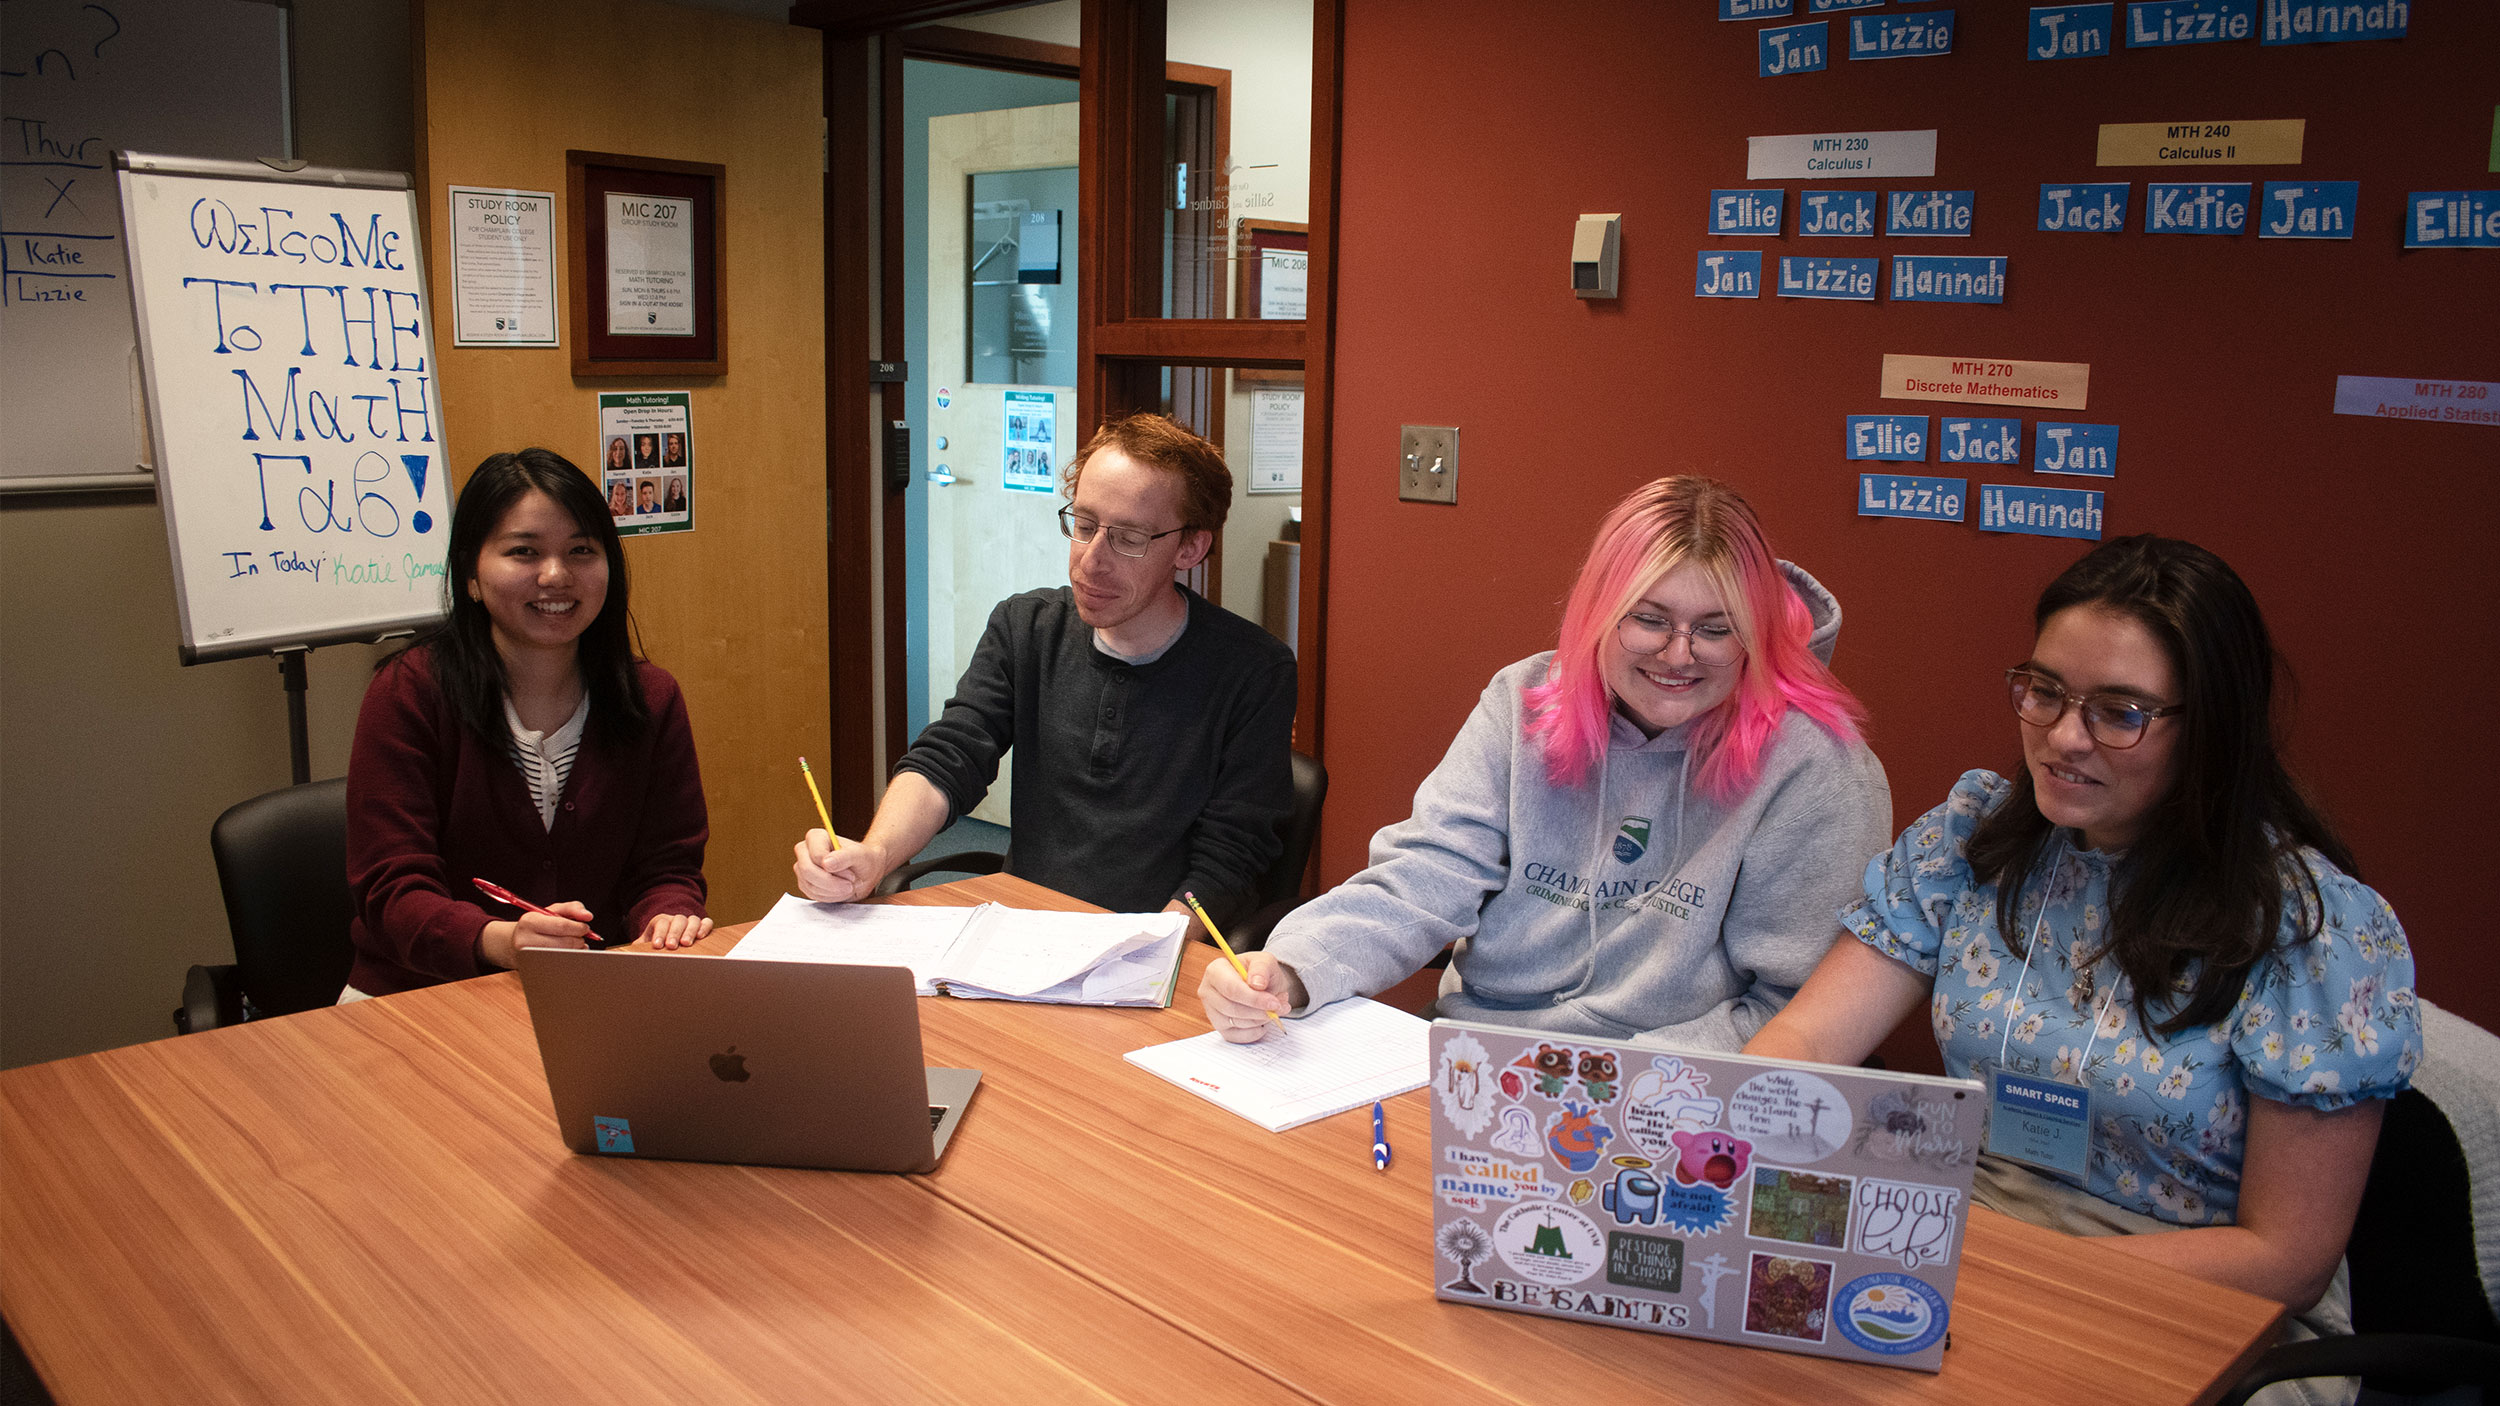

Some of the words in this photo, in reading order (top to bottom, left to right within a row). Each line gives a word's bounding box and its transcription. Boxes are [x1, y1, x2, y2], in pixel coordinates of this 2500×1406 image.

[2036, 14, 2101, 59] Jan
[2132, 5, 2249, 44] Lizzie
[2265, 0, 2408, 41] Hannah
[1768, 33, 1821, 74] Jan
[1854, 18, 1949, 52] Lizzie
[4, 118, 103, 161] Thur
[2167, 126, 2201, 139] MTH
[2203, 125, 2231, 138] 240
[1812, 138, 1842, 152] MTH
[1845, 138, 1869, 152] 230
[2158, 146, 2222, 160] Calculus
[2226, 146, 2236, 159] II
[1807, 157, 1864, 171] Calculus
[1866, 157, 1872, 170] I
[468, 198, 502, 210] STUDY
[505, 200, 538, 212] ROOM
[622, 202, 649, 217] MIC
[654, 204, 678, 219] 207
[1717, 196, 1777, 230] Ellie
[1806, 196, 1872, 234] Jack
[1892, 191, 1970, 230] Katie
[2044, 189, 2122, 232] Jack
[2152, 186, 2245, 230] Katie
[2270, 188, 2343, 235] Jan
[2416, 198, 2500, 242] Ellie
[484, 214, 521, 225] POLICY
[1030, 213, 1045, 223] 208
[24, 240, 85, 266] Katie
[1271, 257, 1290, 269] MIC
[1291, 259, 1307, 270] 208
[1703, 256, 1753, 294] Jan
[1783, 258, 1872, 295] Lizzie
[1894, 260, 2004, 297] Hannah
[18, 277, 87, 302] Lizzie
[269, 283, 425, 373] THE
[879, 363, 895, 373] 208
[1951, 362, 1983, 376] MTH
[1987, 364, 2013, 377] 270
[1906, 379, 1963, 394] Discrete
[1967, 382, 2059, 400] Mathematics
[2415, 383, 2452, 398] MTH
[2456, 386, 2488, 399] 280
[642, 396, 669, 404] Tutoring!
[1269, 403, 1291, 411] POLICY
[2375, 403, 2439, 419] Applied
[1854, 421, 1922, 457] Ellie
[1947, 422, 2019, 461] Jack
[2044, 428, 2108, 471] Jan
[1863, 477, 1960, 517] Lizzie
[1983, 489, 2102, 532] Hannah
[222, 551, 258, 579] In
[333, 553, 397, 586] Katie
[2005, 1084, 2043, 1100] SMART
[2044, 1092, 2079, 1109] SPACE
[1916, 1100, 1957, 1122] RUN
[1629, 1128, 1664, 1138] calling
[1931, 1120, 1954, 1135] TO
[2022, 1120, 2050, 1137] Katie
[2053, 1128, 2062, 1140] J.
[1894, 1128, 1963, 1164] Mary
[1451, 1150, 1456, 1159] I
[1460, 1152, 1488, 1163] have
[1464, 1163, 1537, 1183] called
[1442, 1179, 1515, 1198] name.
[1514, 1182, 1538, 1192] you
[1541, 1184, 1556, 1196] by
[1671, 1189, 1687, 1198] be
[1690, 1190, 1712, 1202] not
[1451, 1197, 1479, 1208] seek
[1860, 1183, 1957, 1219] CHOOSE
[1499, 1219, 1511, 1233] The
[1507, 1204, 1542, 1221] Catholic
[1546, 1204, 1579, 1220] Center
[1579, 1220, 1589, 1228] at
[1861, 1203, 1948, 1270] life
[1619, 1237, 1671, 1257] RESTORE
[1612, 1248, 1631, 1263] ALL
[1637, 1252, 1677, 1270] THINGS
[1613, 1262, 1628, 1275] IN
[1632, 1264, 1674, 1281] CHRIST
[1494, 1281, 1541, 1305] BE
[1552, 1289, 1688, 1328] SAINTS
